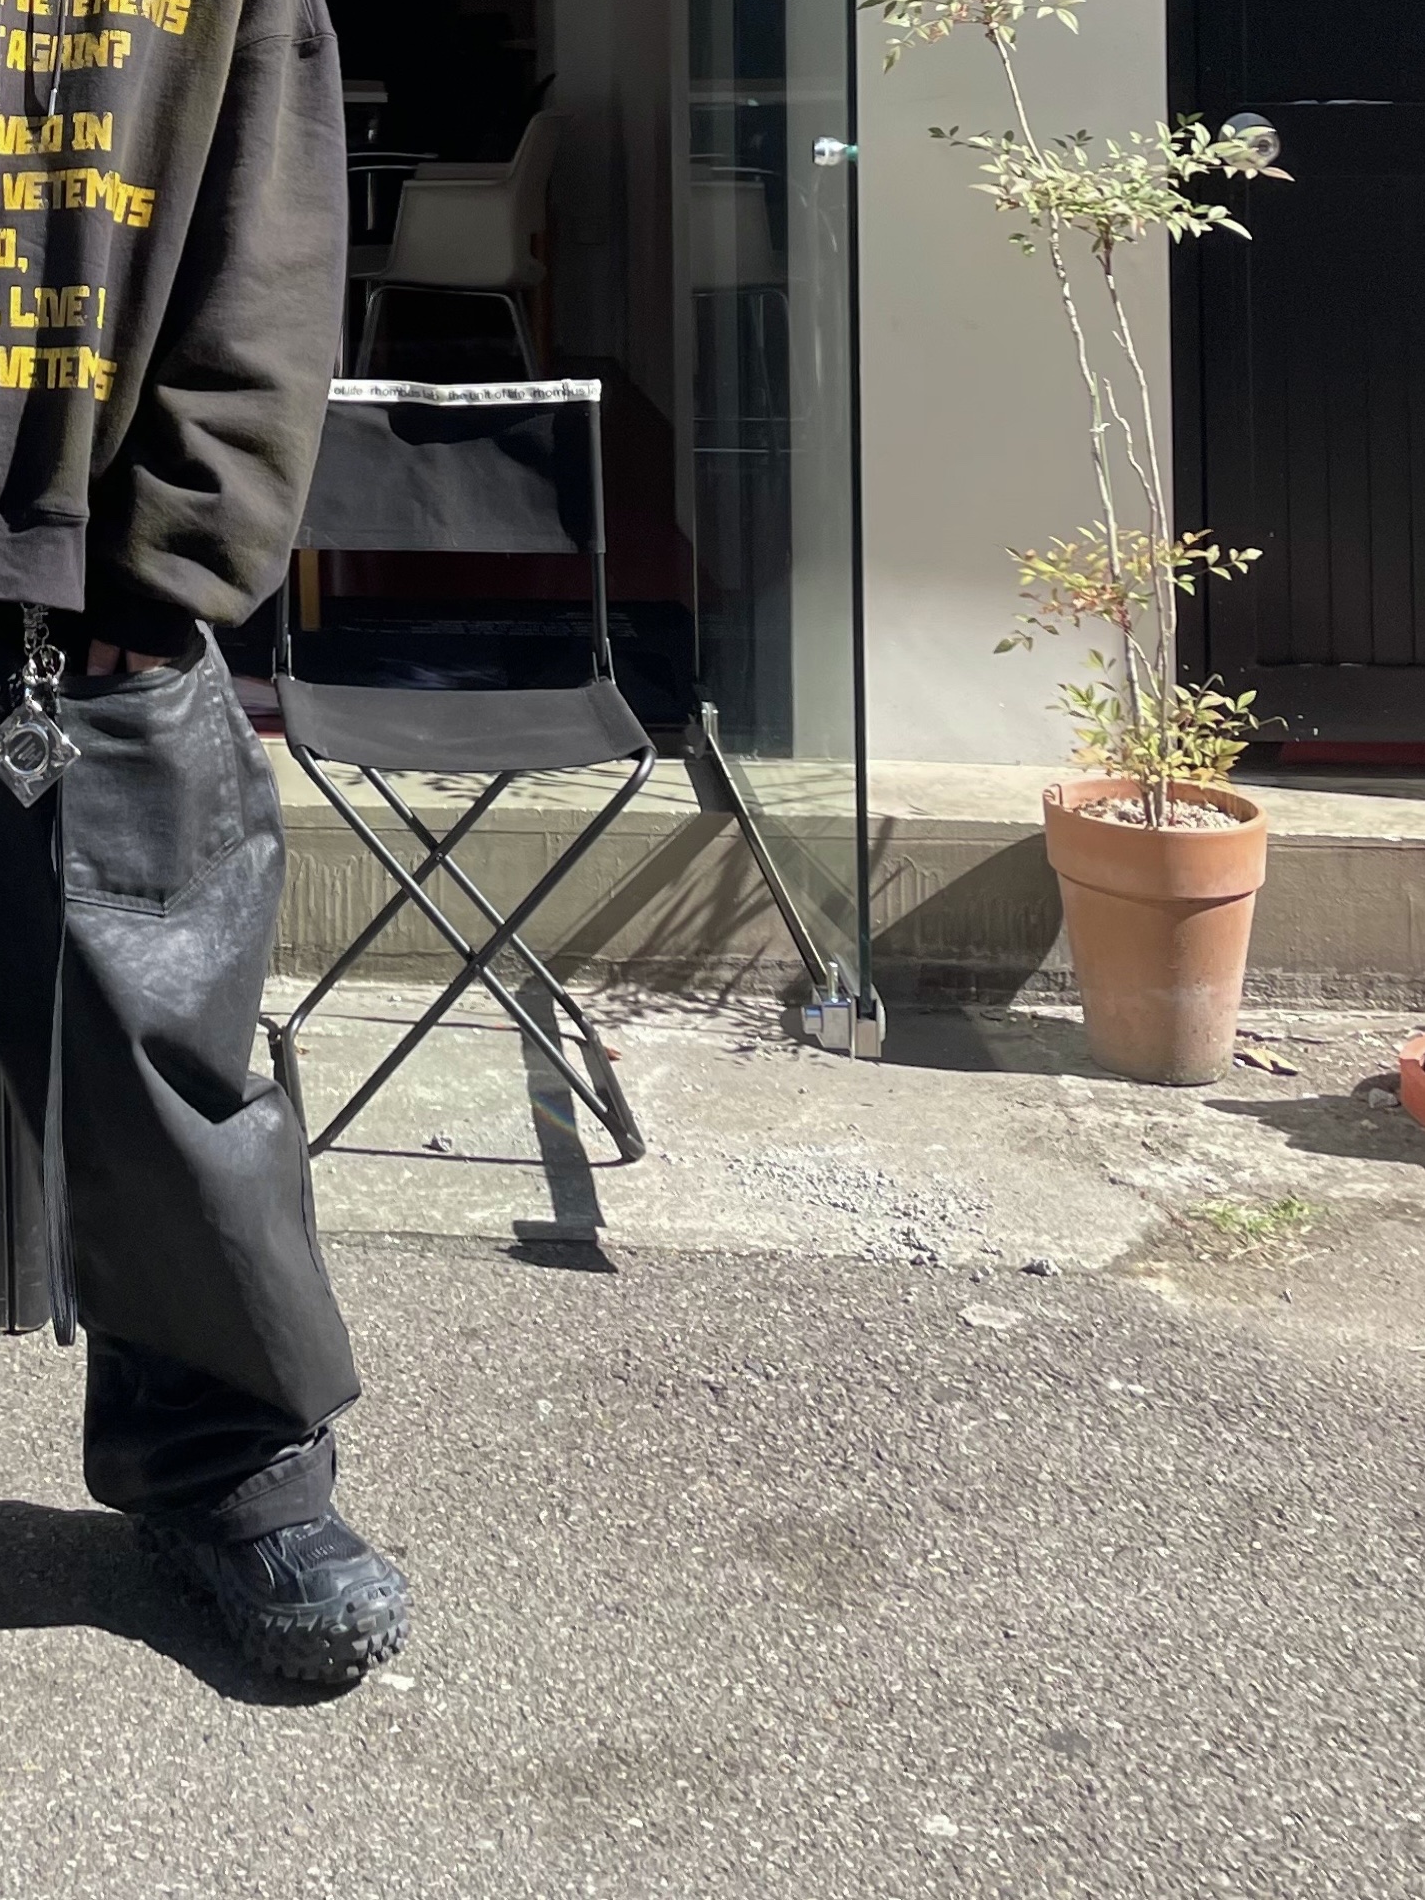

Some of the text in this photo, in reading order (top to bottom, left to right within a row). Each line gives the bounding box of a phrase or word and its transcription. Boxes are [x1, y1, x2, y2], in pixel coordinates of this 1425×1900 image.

[72, 112, 113, 151] IN
[3, 167, 155, 227] VETEMTS
[10, 285, 90, 328] LIVE
[370, 386, 421, 398] rhombus
